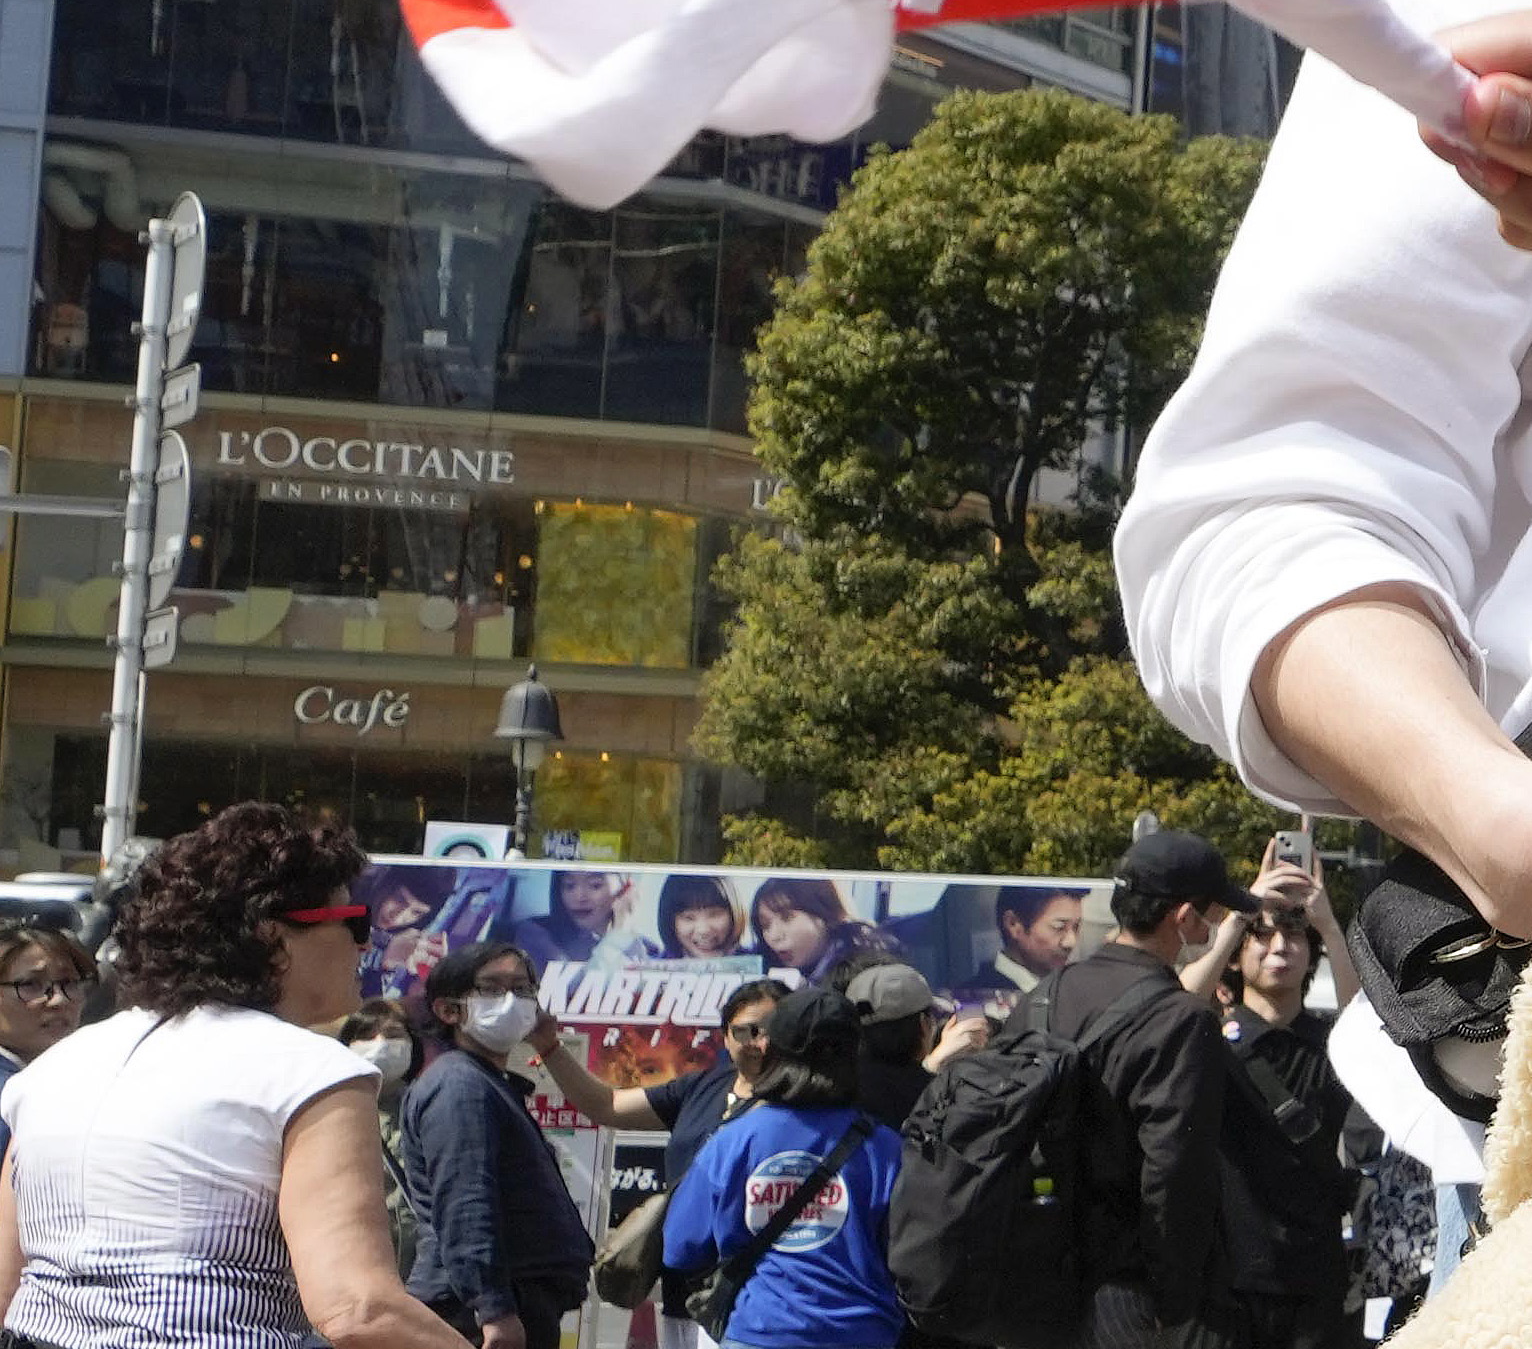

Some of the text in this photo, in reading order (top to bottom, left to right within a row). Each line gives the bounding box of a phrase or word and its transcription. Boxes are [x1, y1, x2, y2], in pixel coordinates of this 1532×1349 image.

[217, 426, 515, 484] L'OCCITANE
[270, 481, 459, 509] EN PROVENCE
[294, 686, 411, 737] Café
